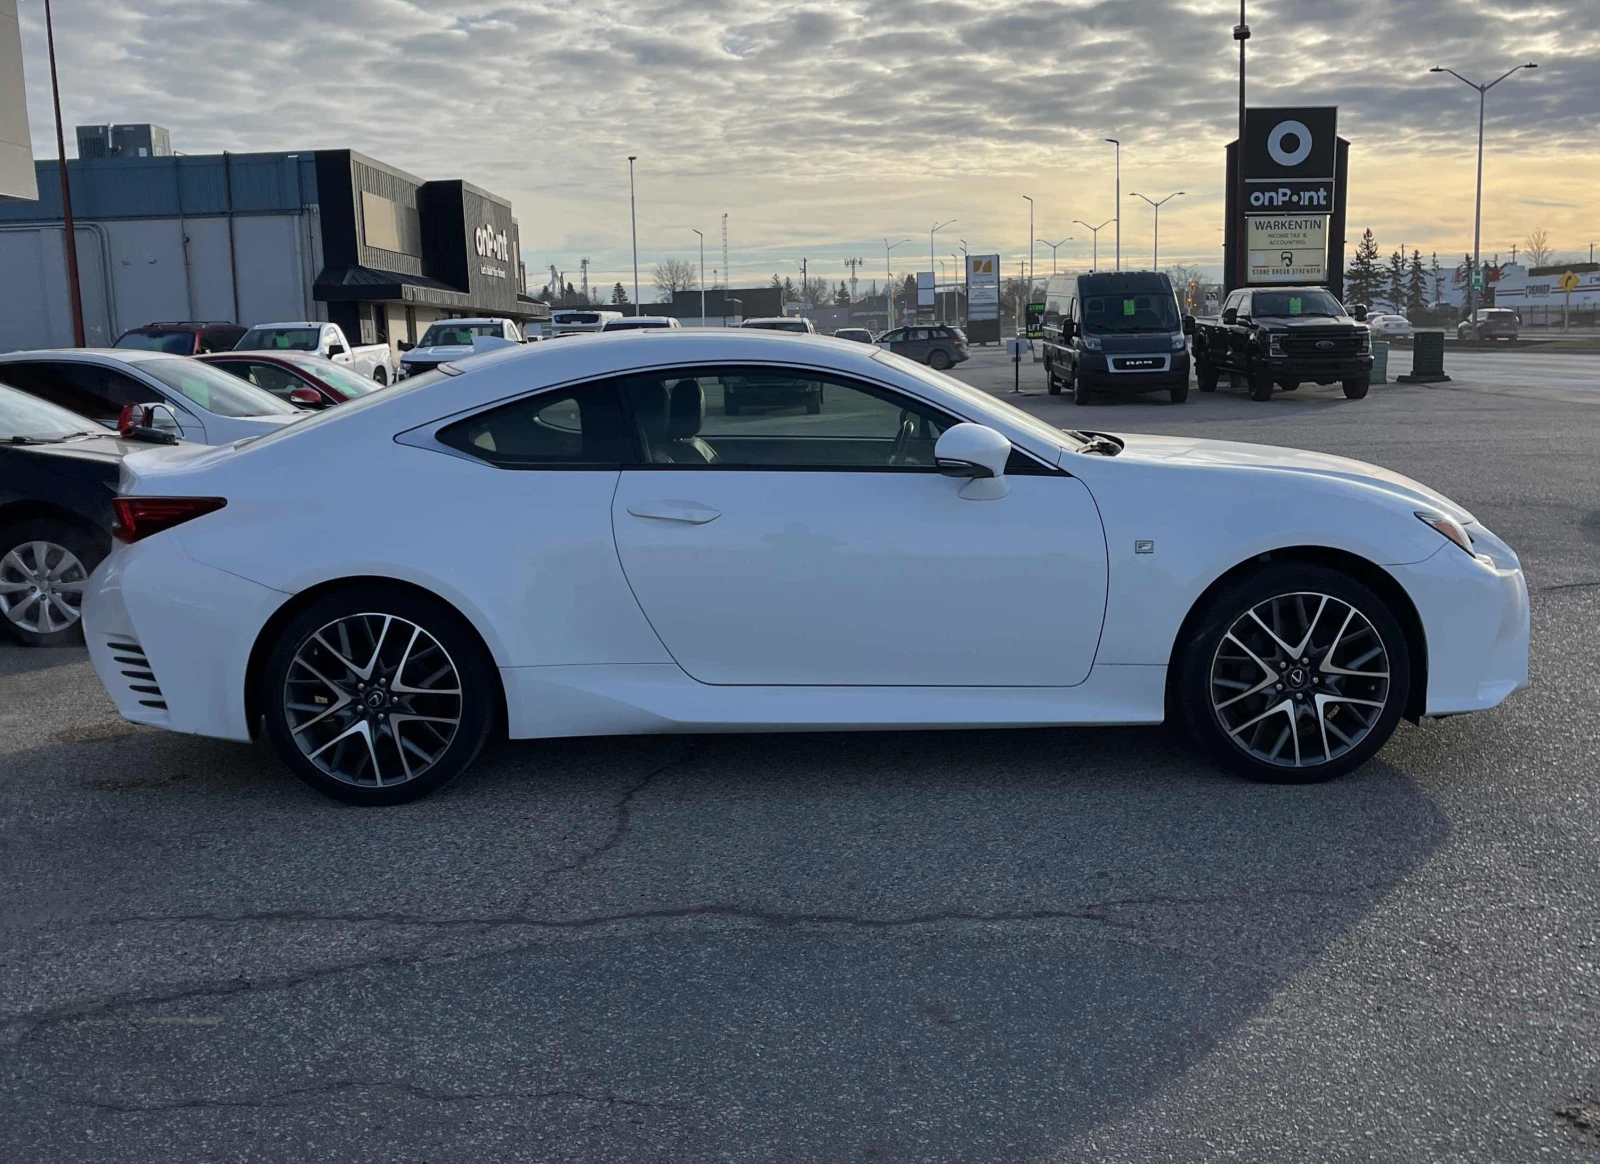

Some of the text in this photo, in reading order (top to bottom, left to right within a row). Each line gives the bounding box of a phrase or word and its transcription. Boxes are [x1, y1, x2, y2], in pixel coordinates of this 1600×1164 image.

[1254, 220, 1322, 231] WARKENTIN
[1292, 267, 1321, 275] STRENGTH
[1471, 271, 1483, 284] H
